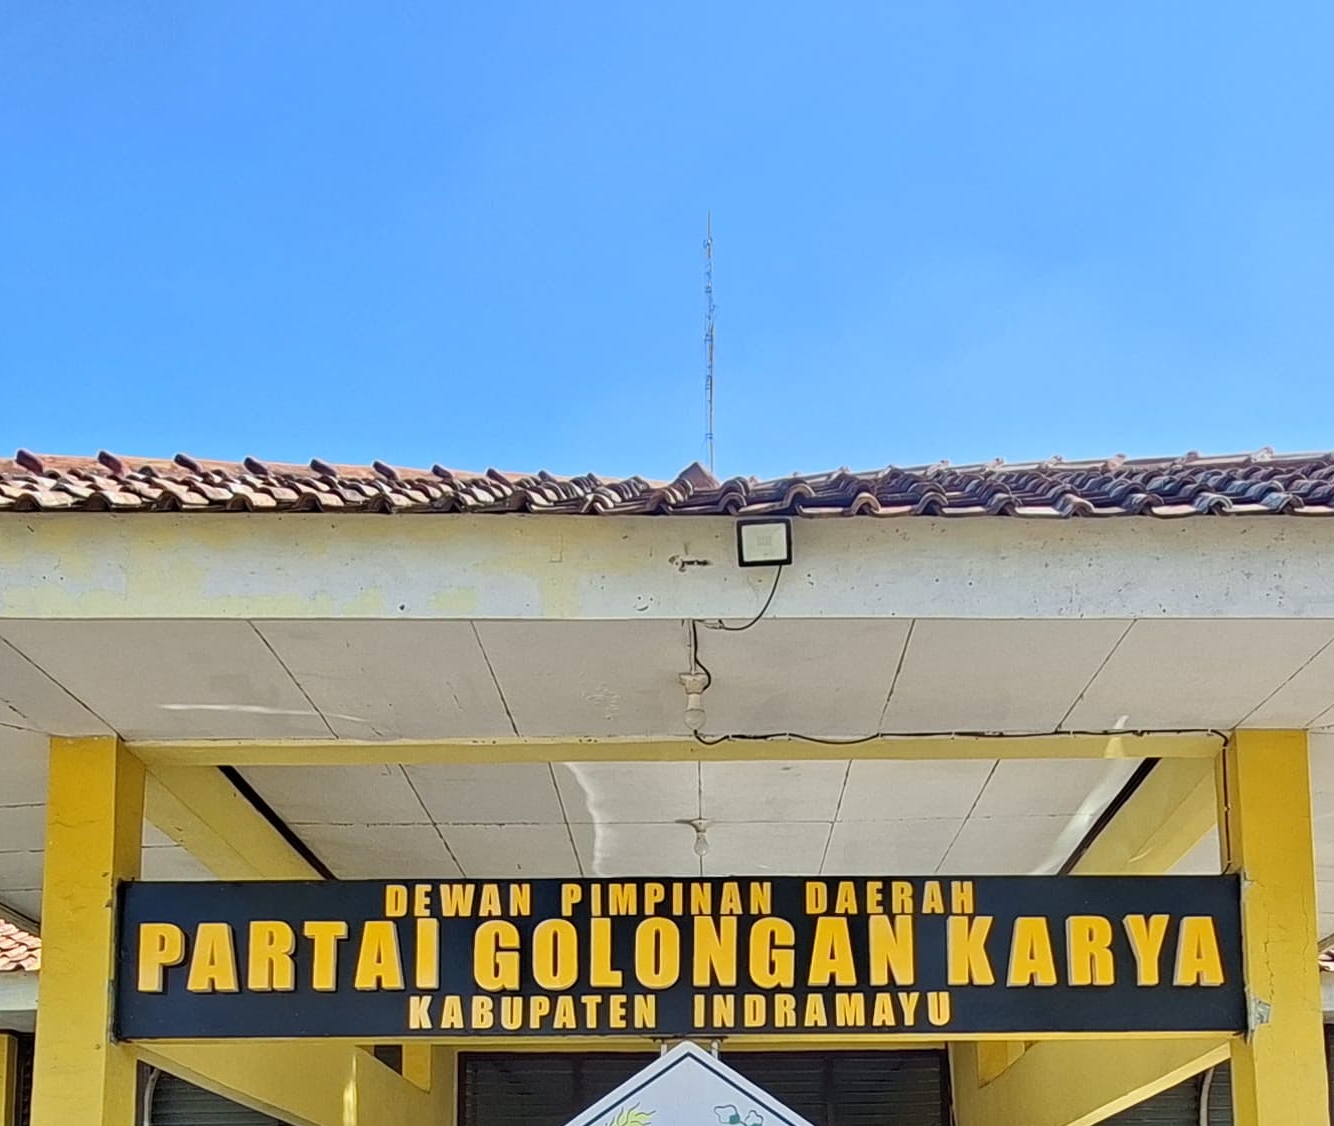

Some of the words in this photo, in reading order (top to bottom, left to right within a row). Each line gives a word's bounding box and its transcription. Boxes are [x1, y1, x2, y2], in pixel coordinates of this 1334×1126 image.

[384, 883, 531, 918] DEWAN
[560, 881, 772, 917] PIMPINAN
[805, 880, 976, 916] DAERAH
[136, 917, 441, 993] PARTAI
[472, 914, 917, 991] GOLONGAN
[945, 914, 1226, 988] KARYA
[408, 993, 657, 1030] KABUPATEN
[693, 991, 952, 1029] INDRAMAYU
